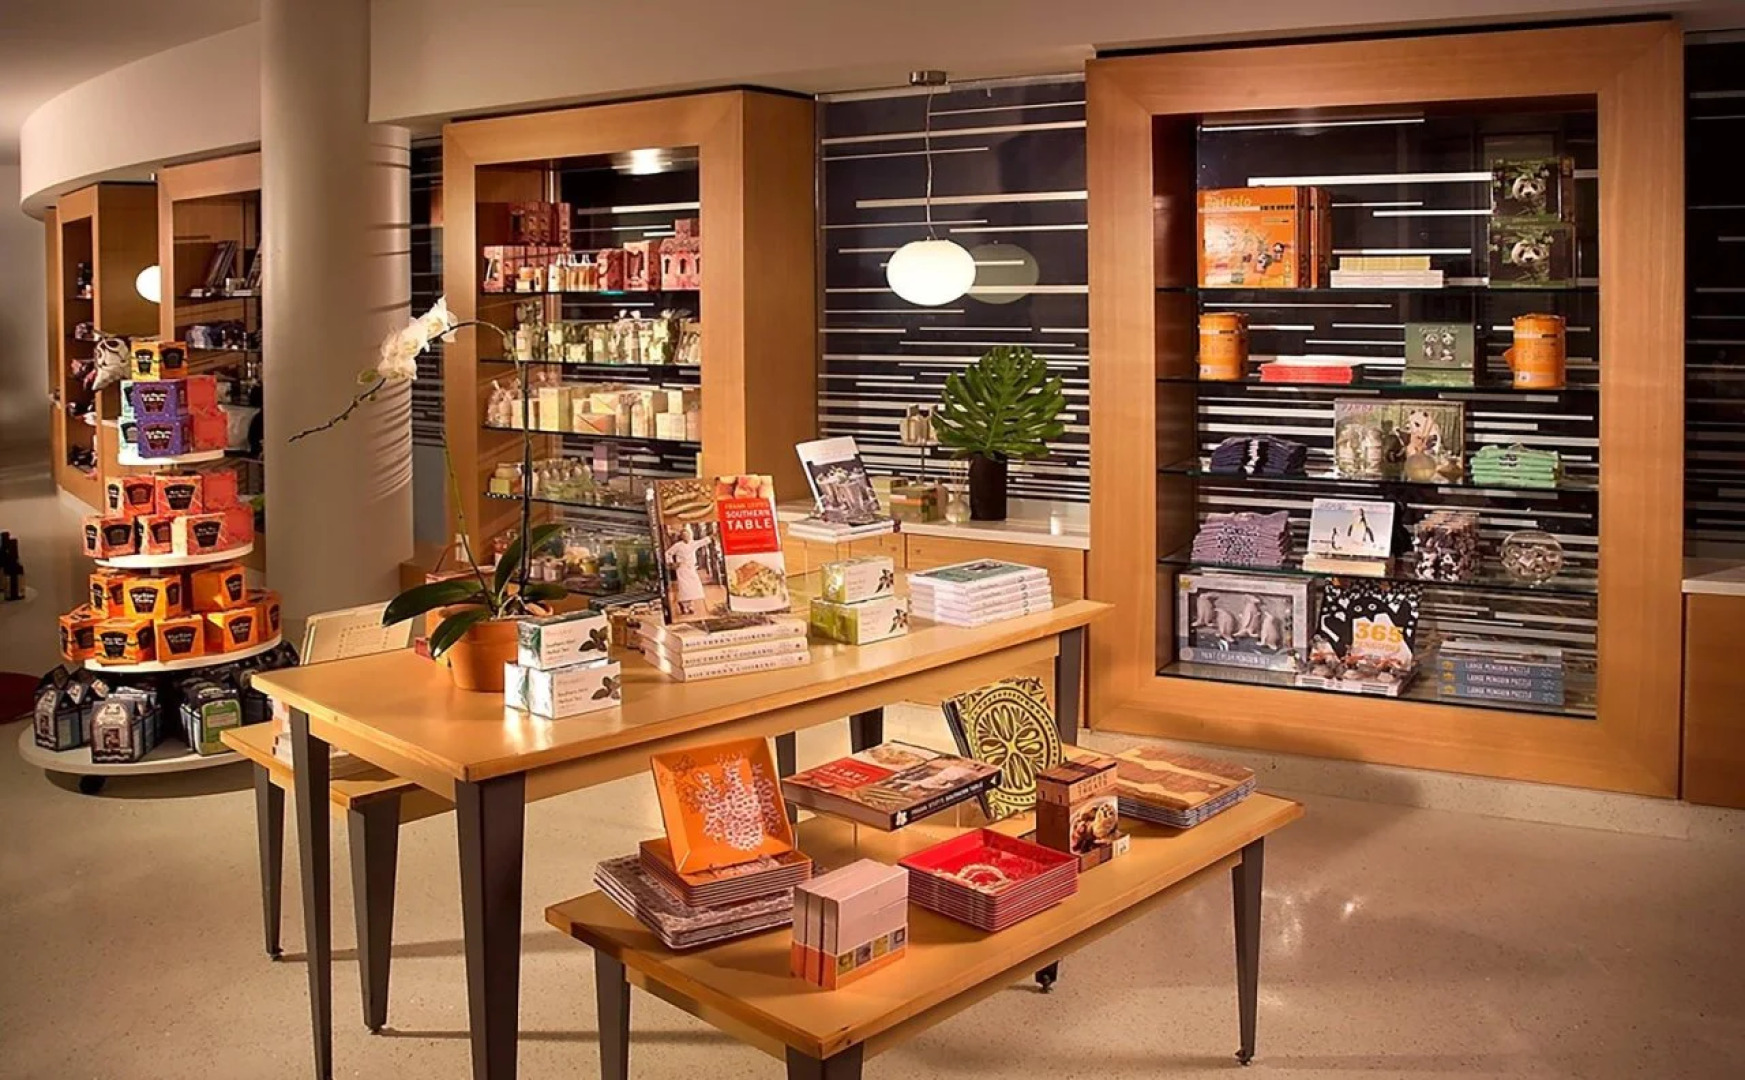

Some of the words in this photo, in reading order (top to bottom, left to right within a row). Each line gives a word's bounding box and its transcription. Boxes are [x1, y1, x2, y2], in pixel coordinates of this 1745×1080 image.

[726, 509, 771, 519] SOUTHERN
[727, 518, 772, 531] TABLE
[686, 638, 731, 647] SOUTHERN
[734, 632, 773, 641] COOKING
[1355, 622, 1404, 644] 365
[686, 654, 731, 664] SOUTHERN
[734, 648, 774, 657] COOKING
[688, 667, 734, 678] SOUTHERN
[736, 662, 776, 672] COOKING
